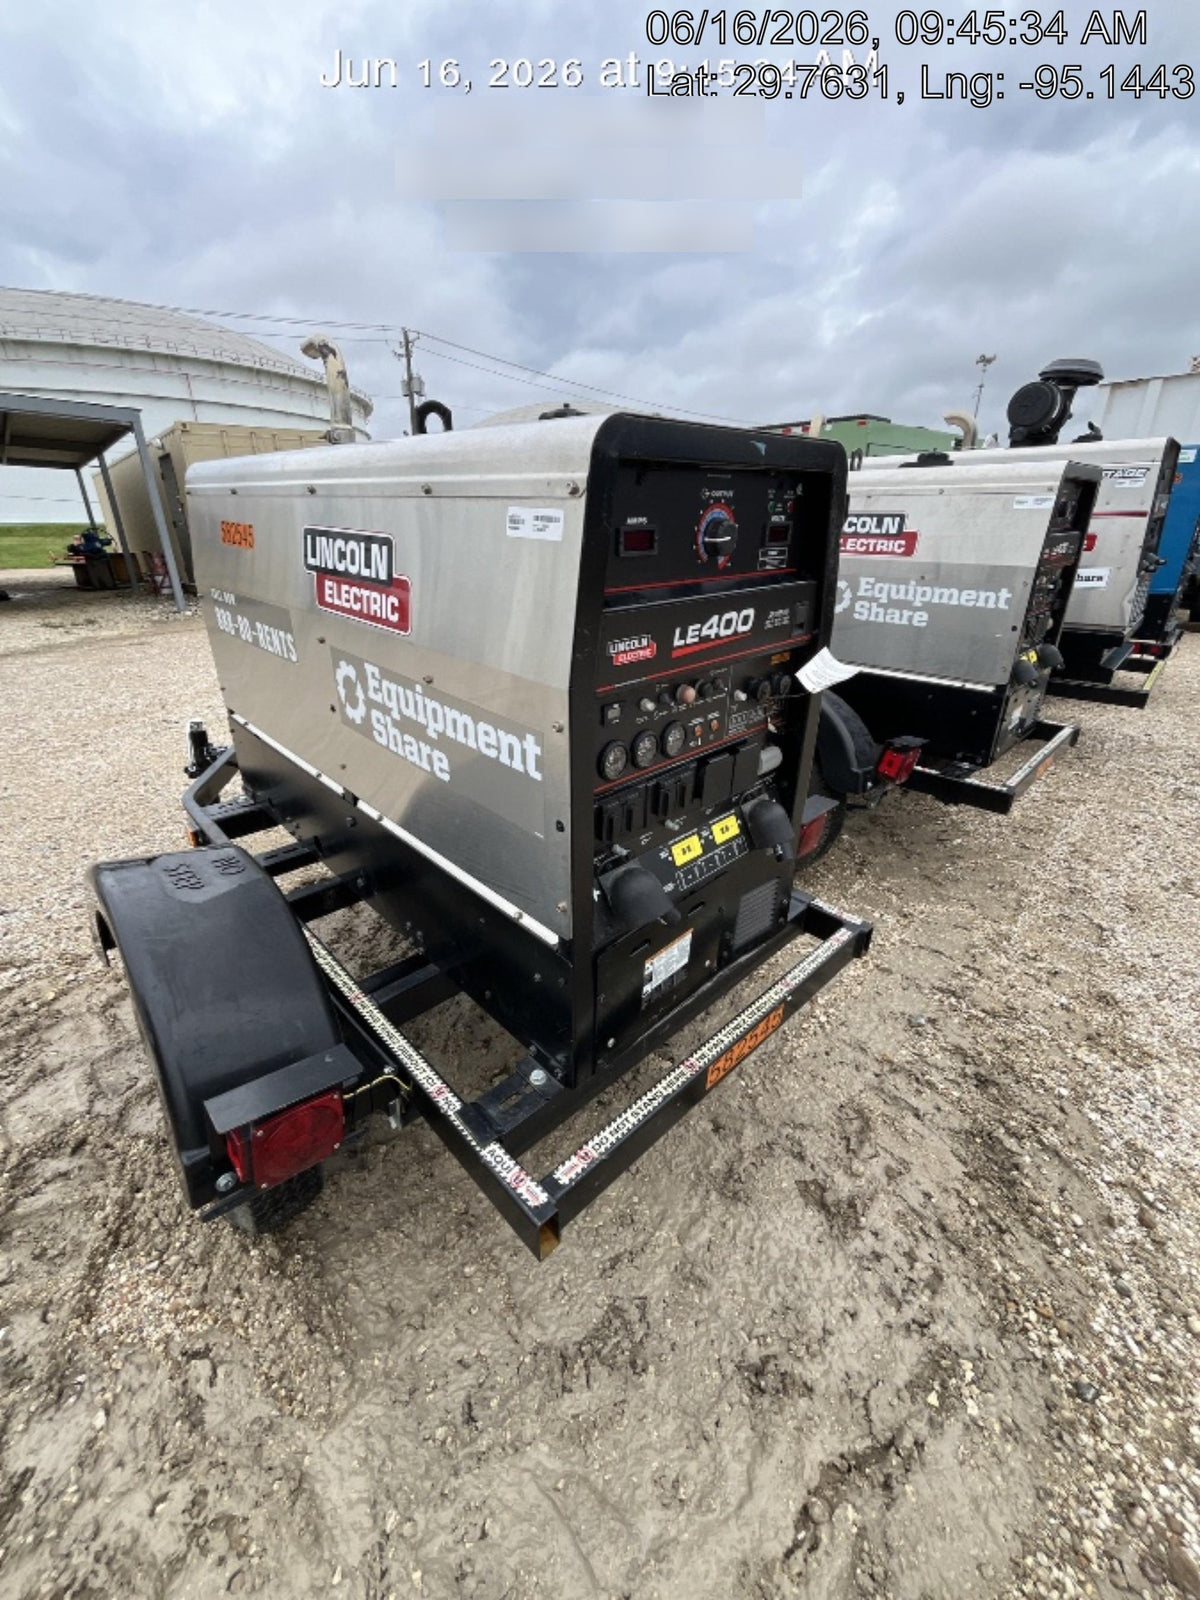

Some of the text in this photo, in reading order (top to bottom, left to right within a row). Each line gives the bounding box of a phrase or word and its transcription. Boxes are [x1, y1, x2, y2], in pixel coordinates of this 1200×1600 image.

[843, 517, 900, 534] COLN
[306, 535, 388, 580] LINCOLN
[840, 539, 906, 553] LECTRIC
[324, 580, 399, 623] ELECTRIC
[857, 577, 1013, 610] Equipment
[673, 608, 755, 648] LE400
[853, 600, 929, 628] Share
[609, 637, 648, 653] LINCOLN
[365, 662, 543, 781] Equipment
[371, 709, 451, 783] Share
[592, 1135, 610, 1151] DO
[609, 1117, 631, 1137] NOT
[631, 1089, 665, 1119] STAND
[487, 1148, 513, 1174] AQUI
